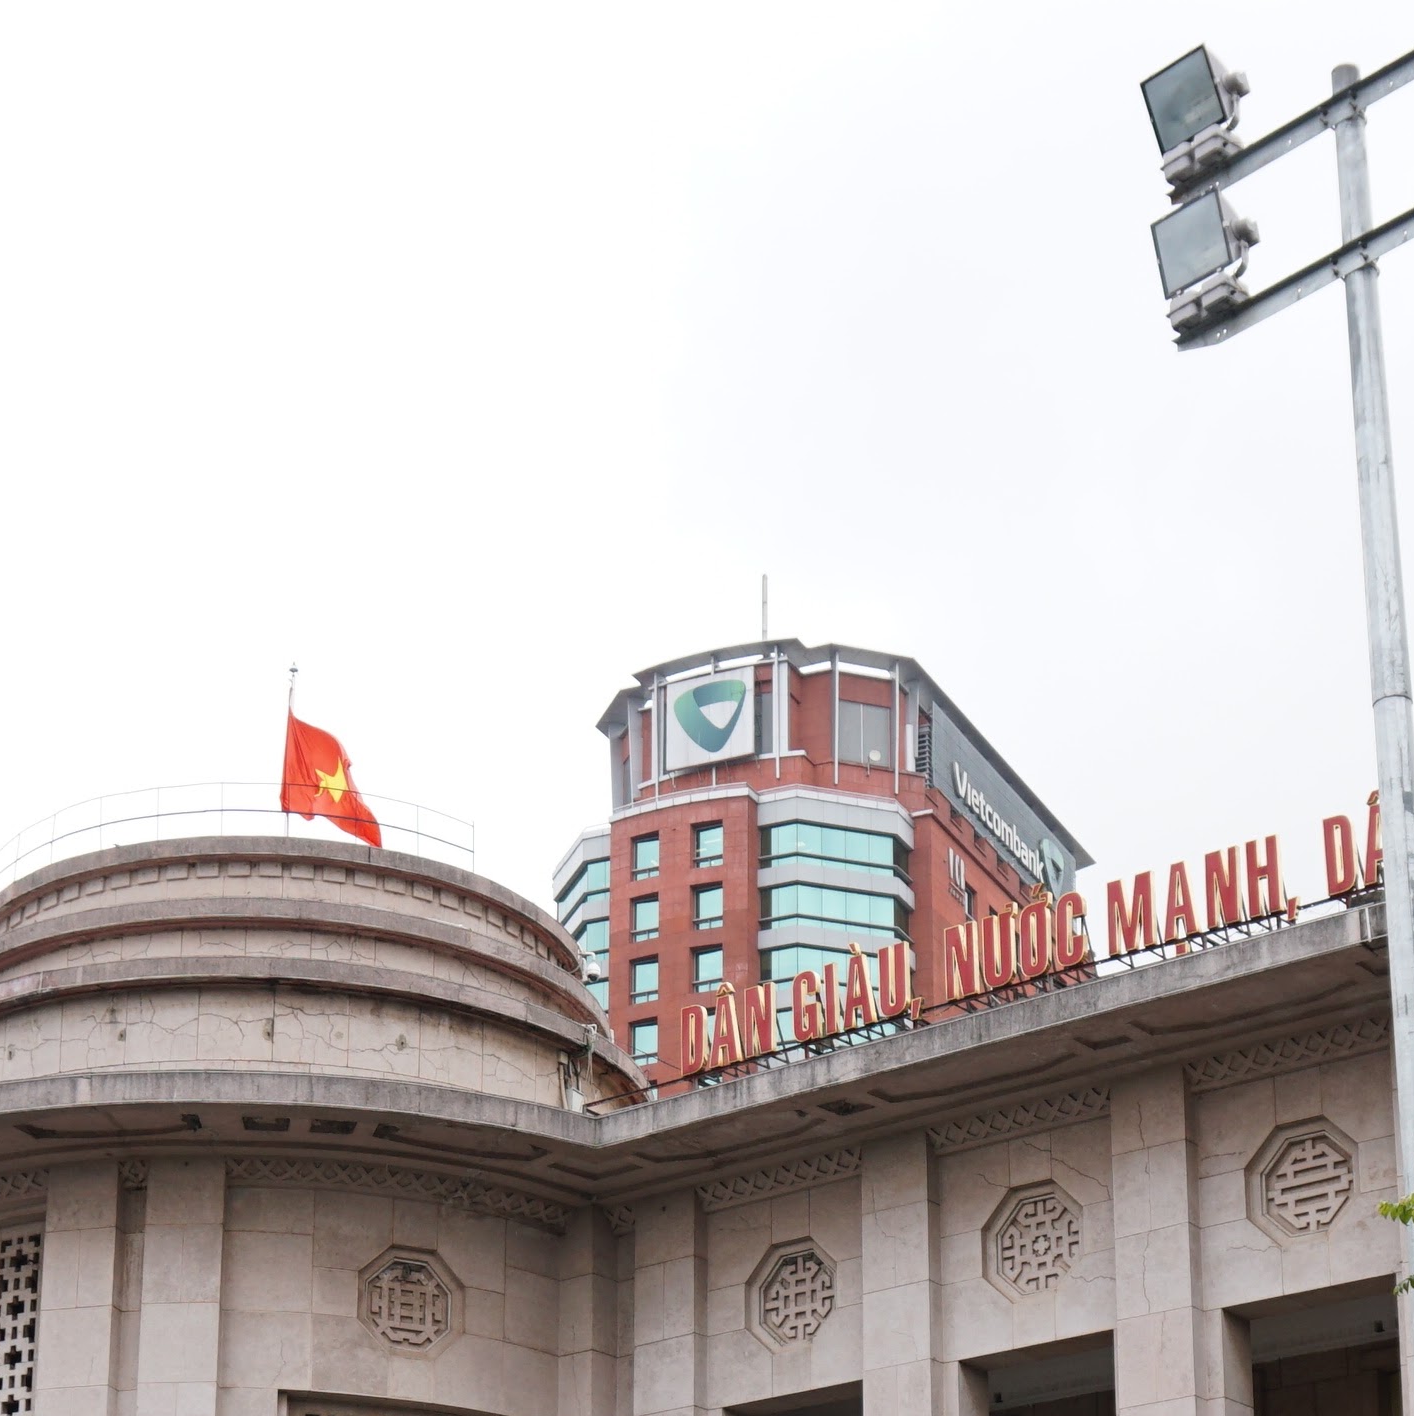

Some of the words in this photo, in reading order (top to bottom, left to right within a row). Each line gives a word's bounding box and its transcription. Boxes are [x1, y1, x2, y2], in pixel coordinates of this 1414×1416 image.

[952, 761, 1045, 884] Vietcombank
[681, 981, 776, 1077] DÂN
[792, 941, 924, 1043] GIÀU,
[944, 882, 1088, 1000] NƯỚC
[1106, 834, 1300, 957] MẠNH,
